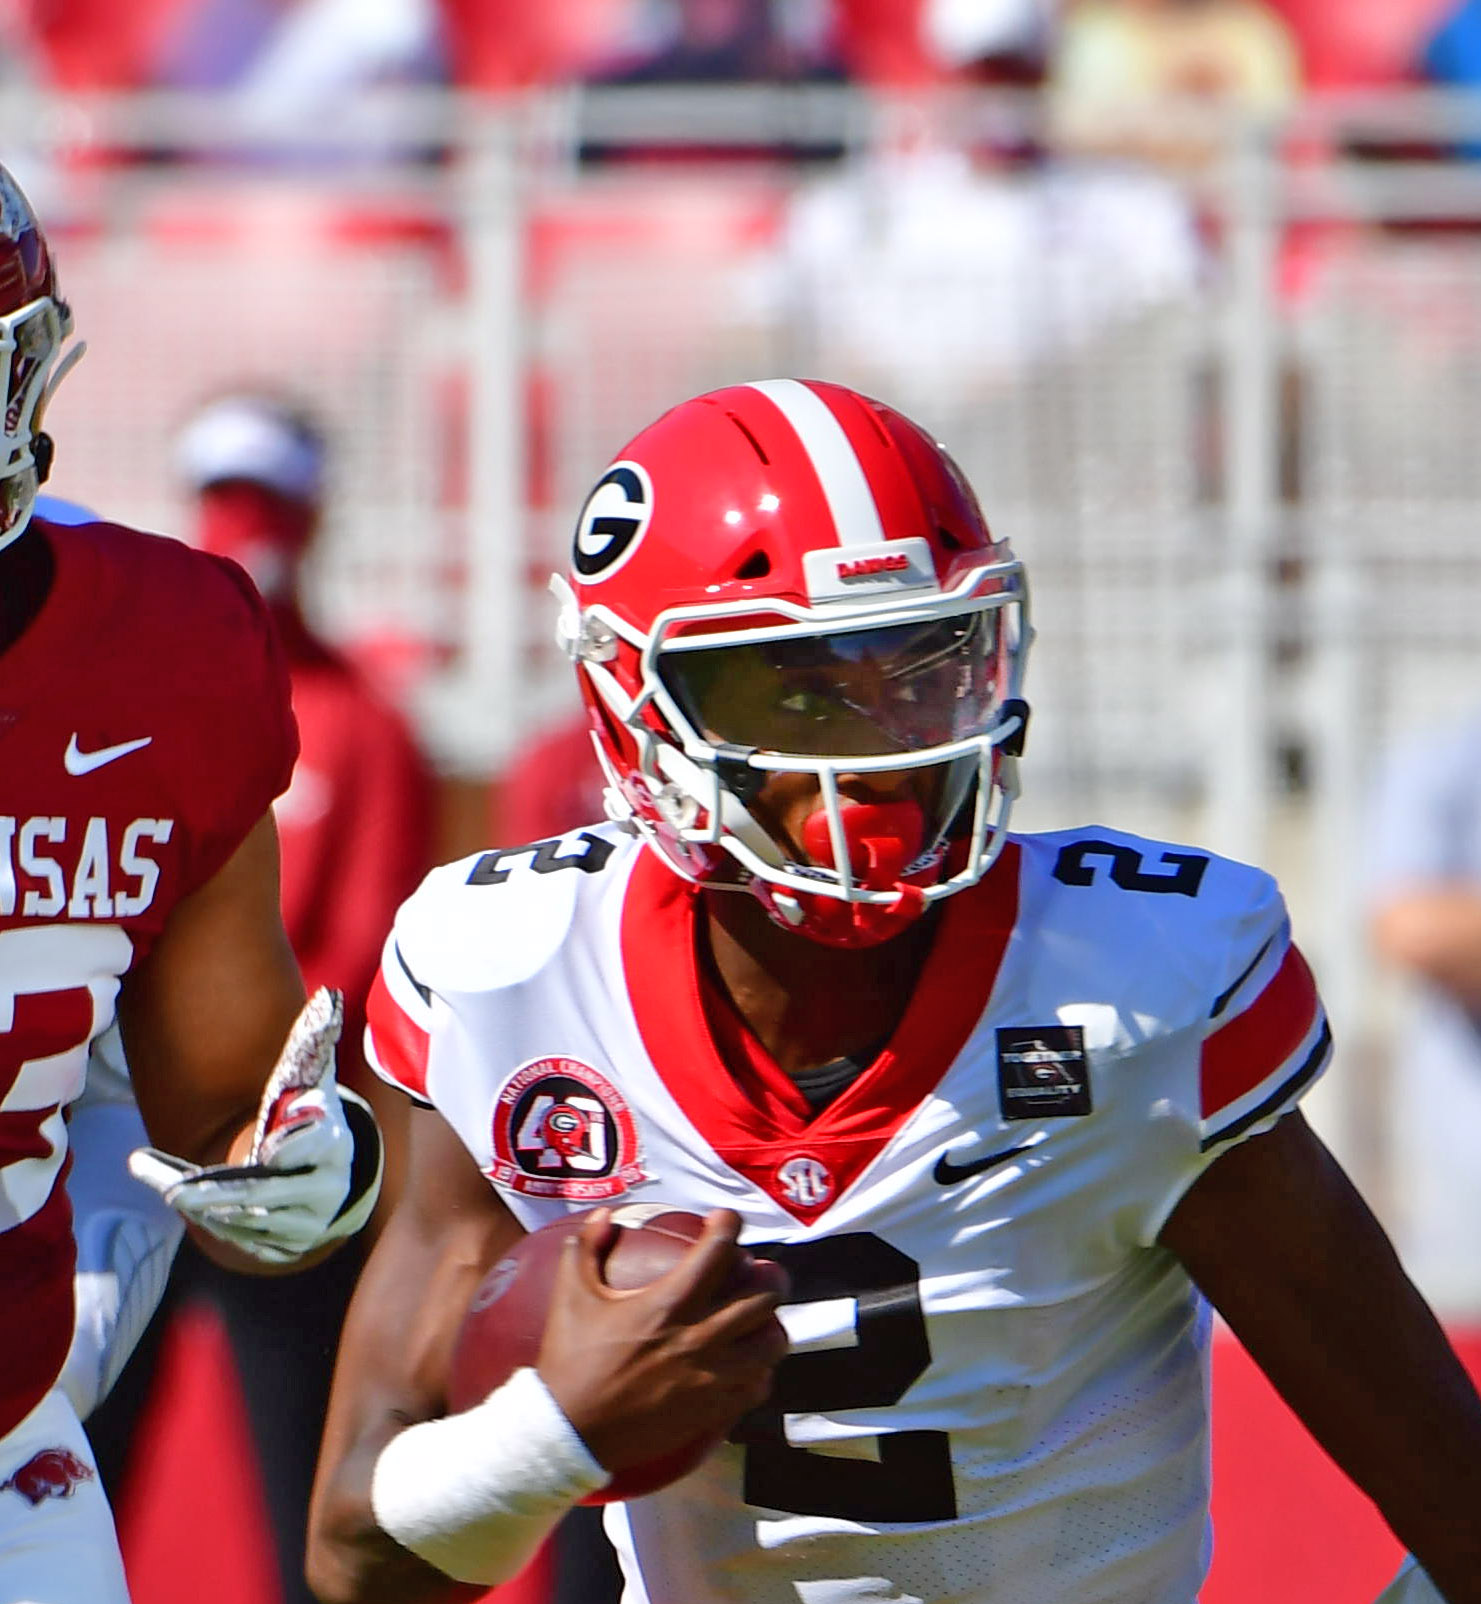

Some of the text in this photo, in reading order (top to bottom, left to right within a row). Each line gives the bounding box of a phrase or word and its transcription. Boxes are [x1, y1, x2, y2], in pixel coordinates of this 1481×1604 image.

[572, 460, 655, 585] G
[1052, 840, 1210, 898] 2
[777, 1156, 829, 1207] SEC
[716, 1231, 958, 1524] 2
